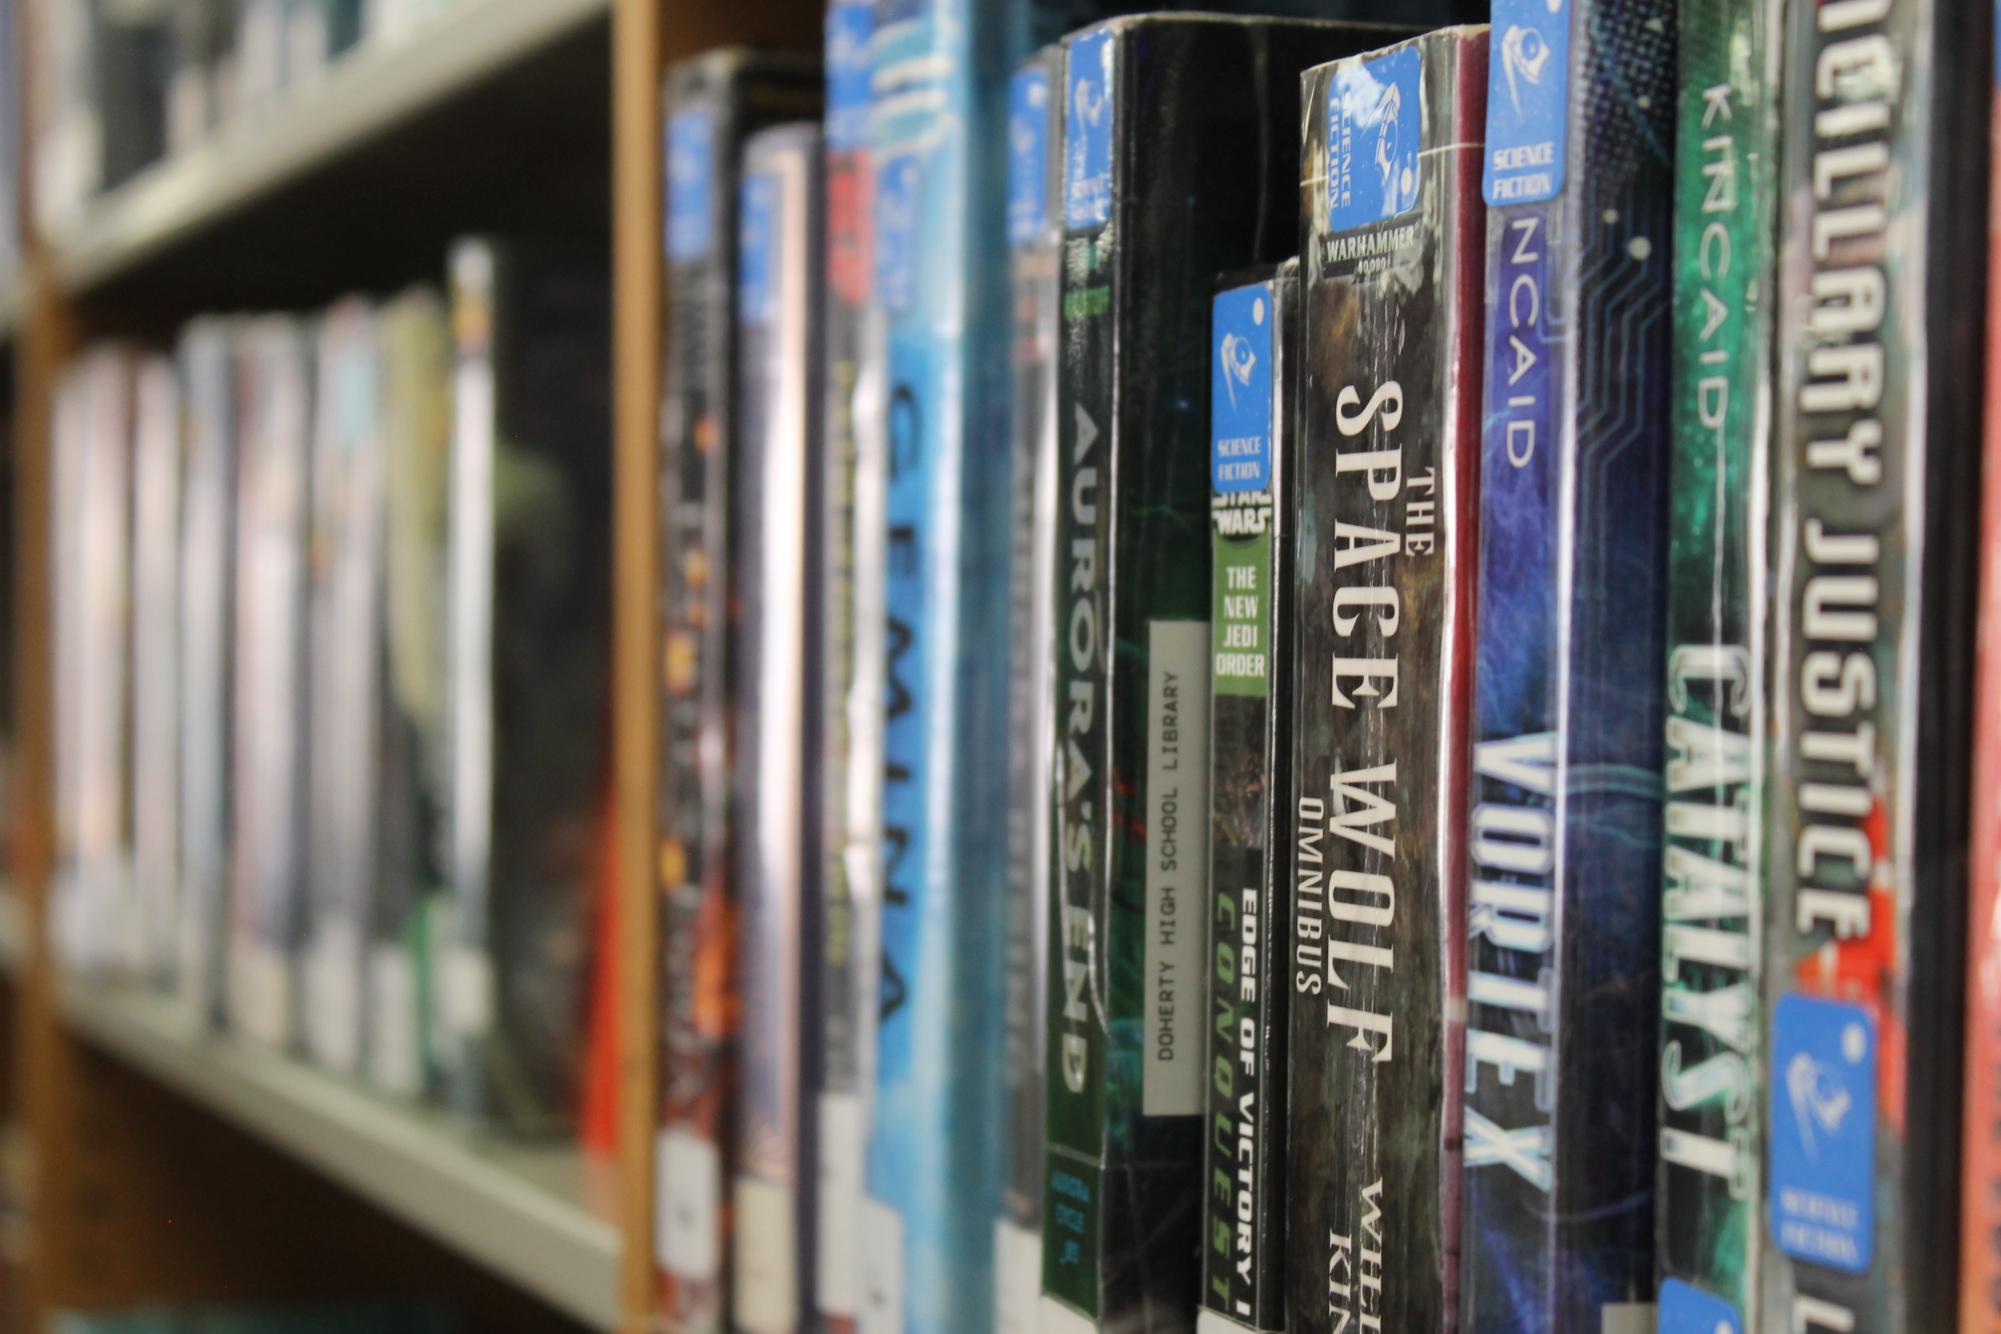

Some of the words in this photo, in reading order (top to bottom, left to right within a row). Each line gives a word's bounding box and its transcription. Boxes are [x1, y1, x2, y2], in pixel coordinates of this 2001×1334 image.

[1491, 172, 1552, 201] FICTION
[1492, 141, 1554, 172] SCIENCE
[1326, 225, 1414, 263] WARHAMMER
[1699, 82, 1736, 430] KINCAID
[1802, 0, 1898, 486] CILLARY
[1217, 436, 1262, 457] SCIENCE
[1217, 461, 1261, 480] FICTION
[1212, 507, 1272, 535] WARS
[1331, 380, 1402, 710] SPACE
[1405, 466, 1435, 557] THE
[1223, 595, 1258, 619] NEW
[1226, 566, 1257, 590] THE
[1066, 402, 1099, 872] AURORA'S
[1215, 653, 1265, 677] ORDER
[1222, 624, 1259, 648] JEDI
[1162, 670, 1180, 770] LIBRARY
[1796, 518, 1880, 941] JUSTICE
[1160, 787, 1178, 872] SCHOOL
[1160, 887, 1176, 945] HIGH
[1239, 888, 1258, 1003] EDGE
[1295, 797, 1325, 995] OMNIBUS
[1326, 757, 1398, 1063] WOLF
[1659, 644, 1753, 1199] CATALYST
[1062, 905, 1093, 1094] END
[1157, 961, 1175, 1061] DOHERTY
[1462, 730, 1557, 1193] VORTEX
[1239, 1017, 1256, 1076] OF
[1211, 893, 1237, 1313] CONQUEST
[1236, 1091, 1255, 1286] VICTORY
